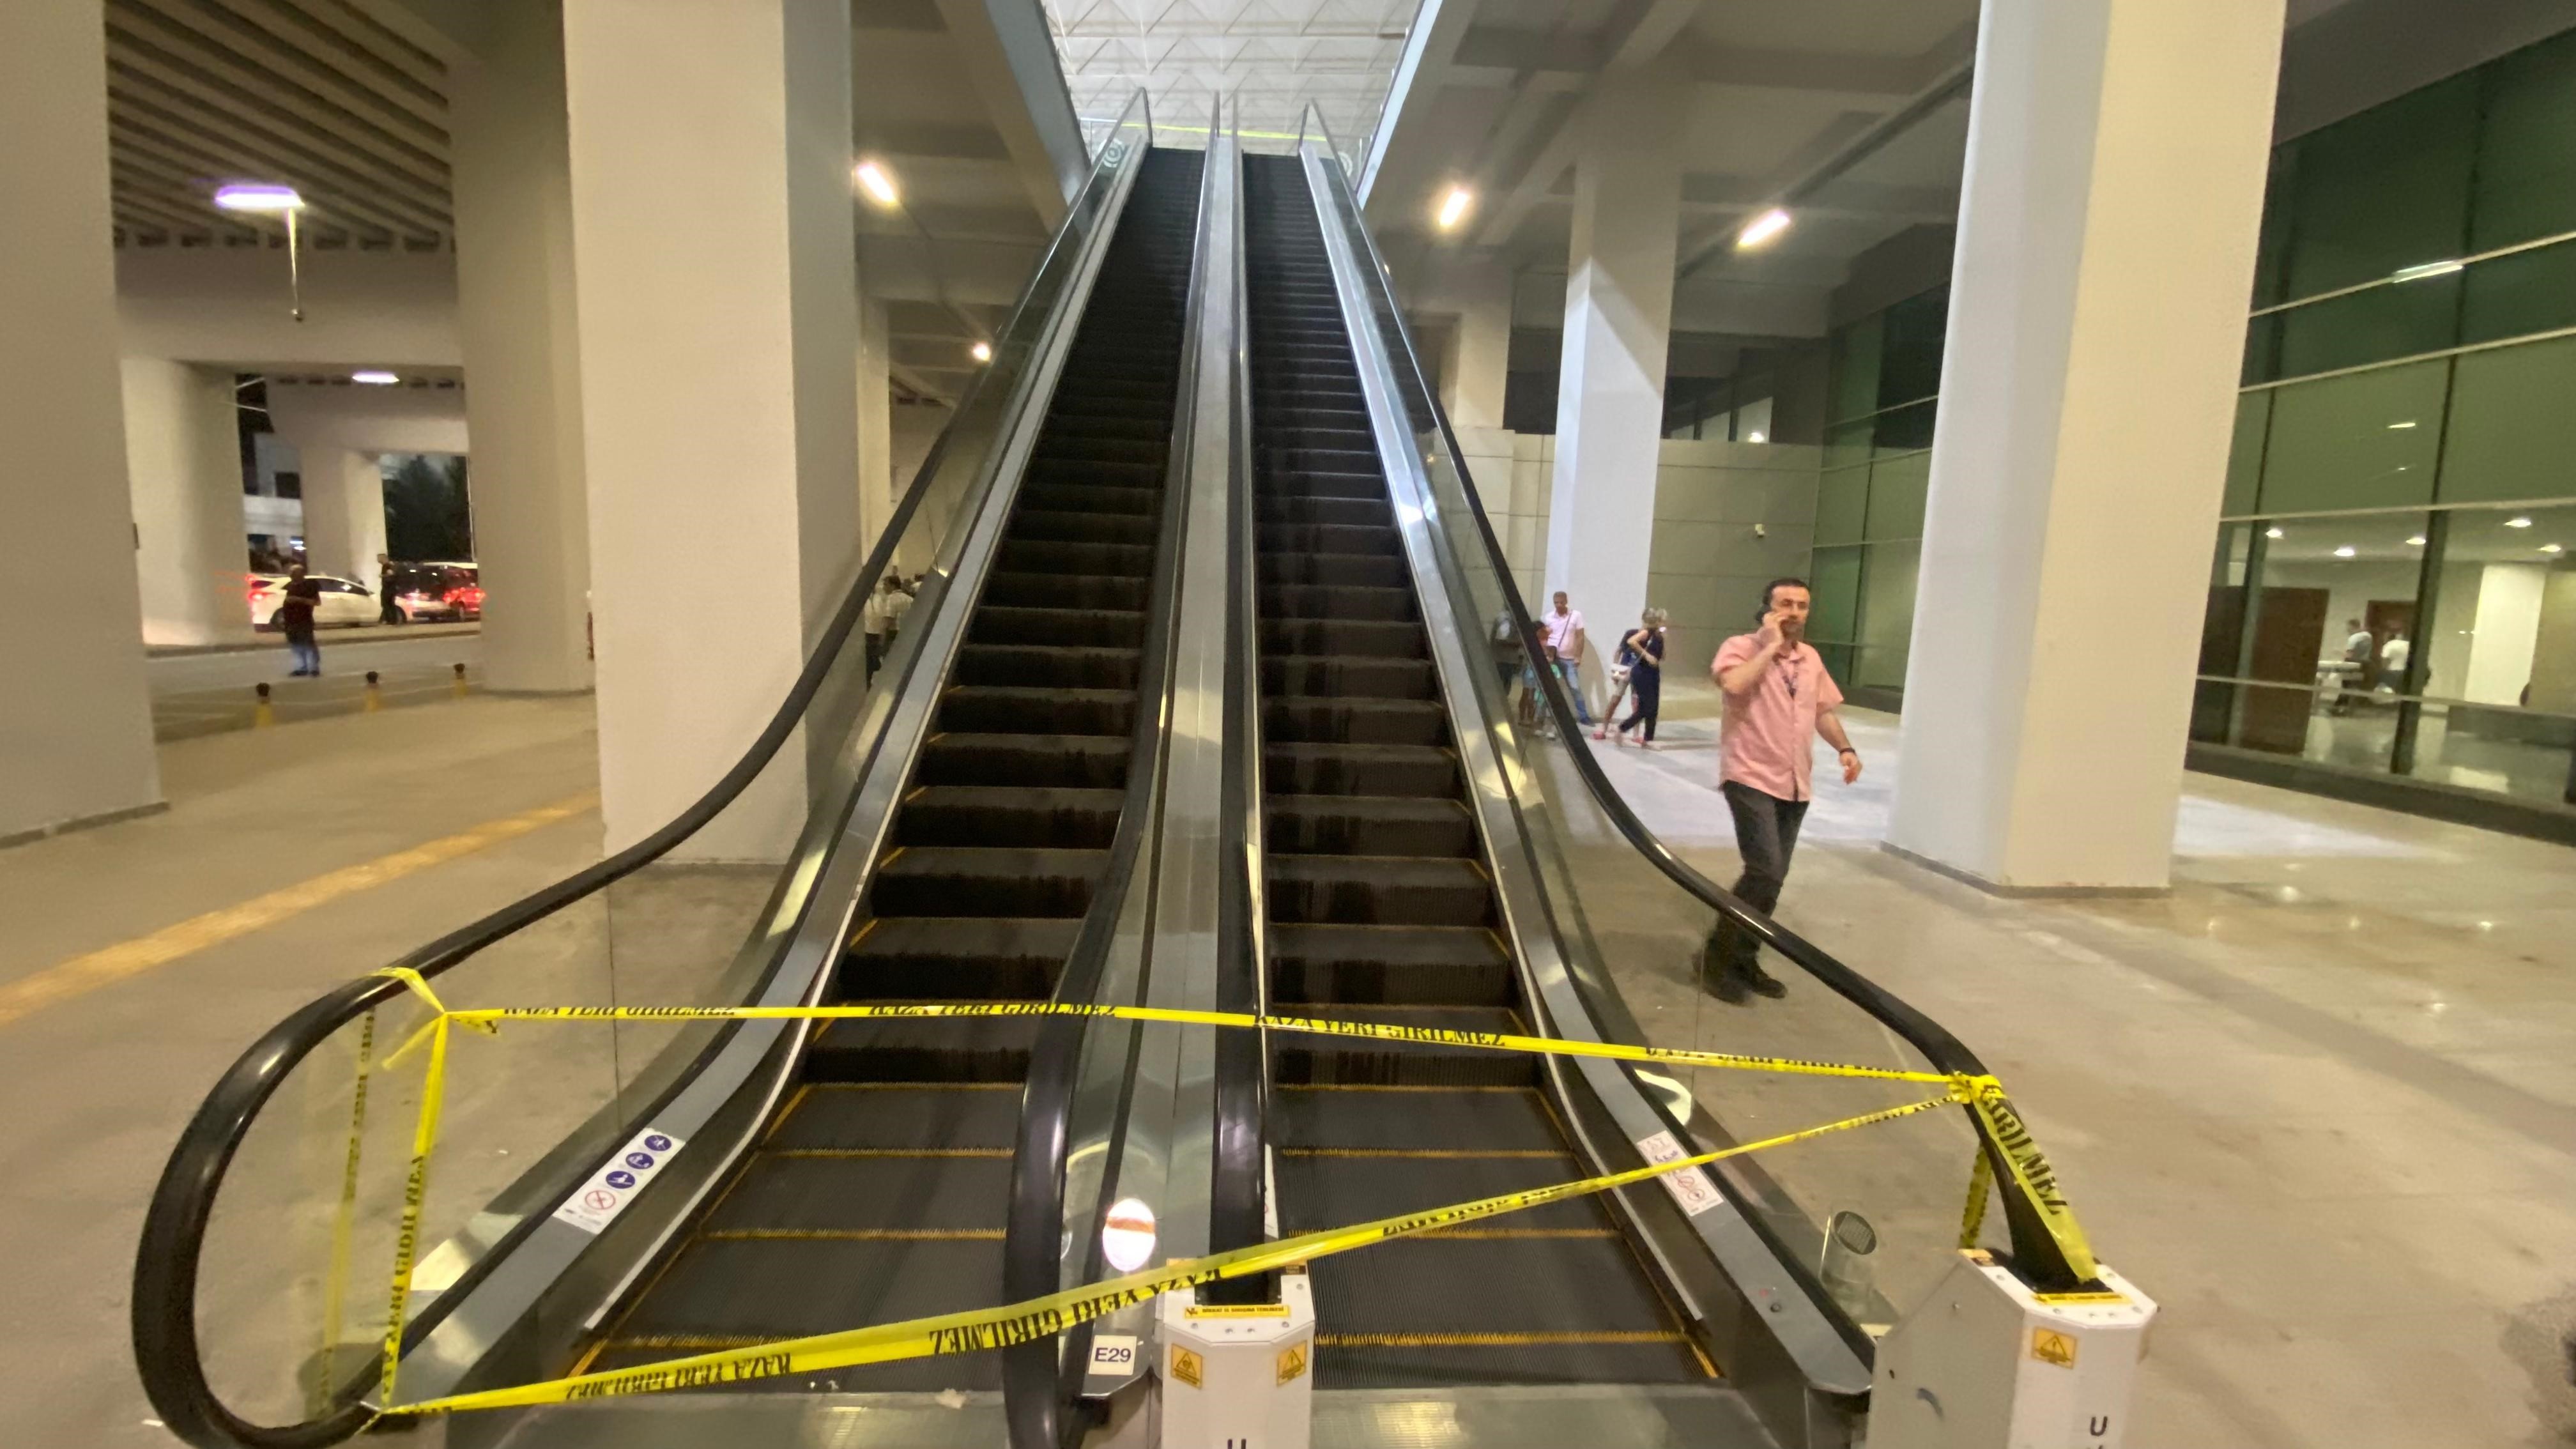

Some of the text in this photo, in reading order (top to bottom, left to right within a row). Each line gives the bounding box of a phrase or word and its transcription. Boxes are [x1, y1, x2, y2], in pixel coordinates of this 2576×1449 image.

[930, 1307, 1063, 1354] GIRILMEZ
[1094, 1347, 1131, 1363] E29
[2090, 1416, 2108, 1437] U
